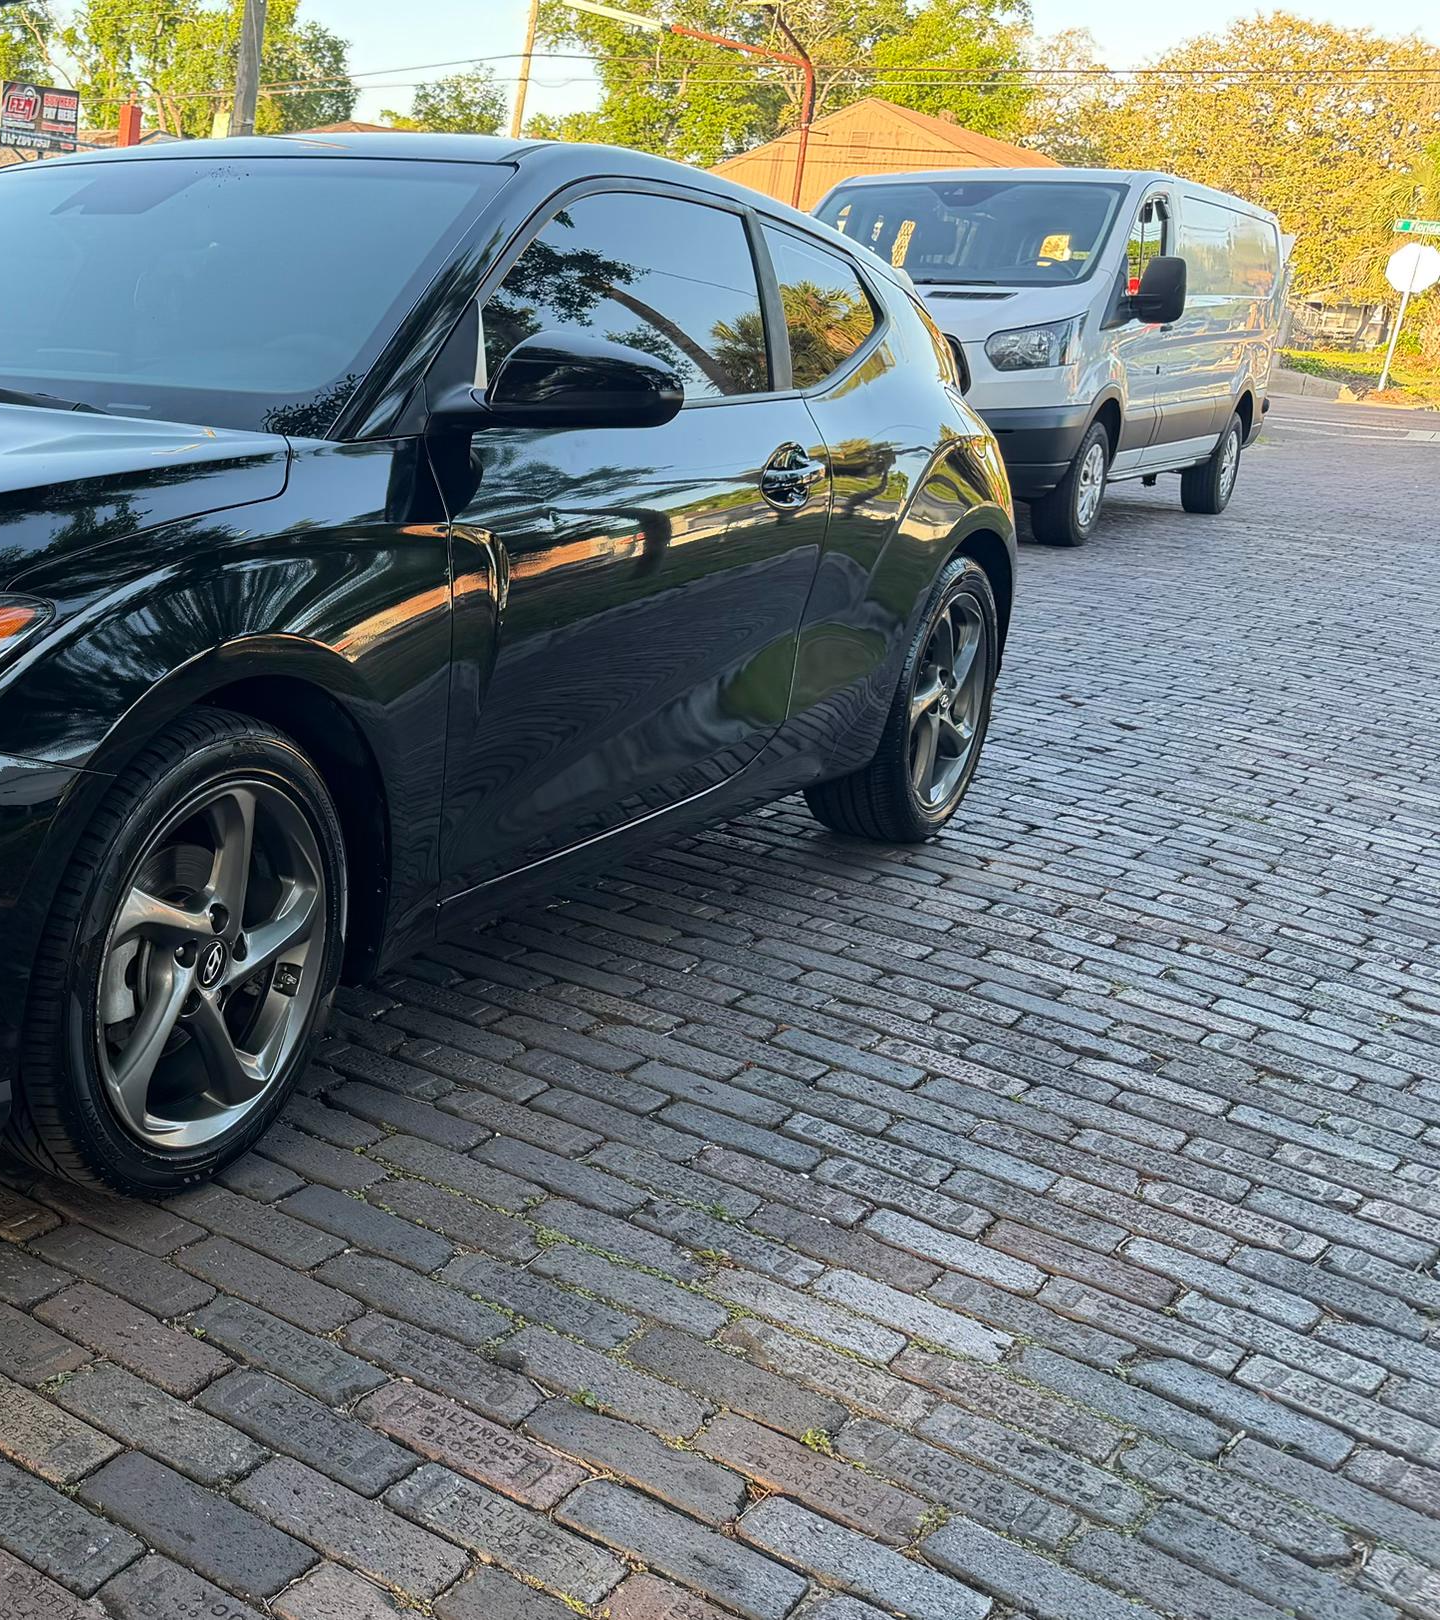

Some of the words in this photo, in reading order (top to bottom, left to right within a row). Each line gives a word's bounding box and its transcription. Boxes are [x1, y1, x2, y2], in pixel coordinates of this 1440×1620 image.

[415, 1425, 500, 1471] BLOCK
[416, 1398, 547, 1465] BALTIMORE
[735, 1448, 870, 1519] BALTIMORE
[777, 1443, 862, 1489] BLOCK
[876, 1454, 1016, 1524] BALTIMORE
[917, 1449, 1005, 1495] BLOCK
[452, 1484, 585, 1559] BALTIMORE
